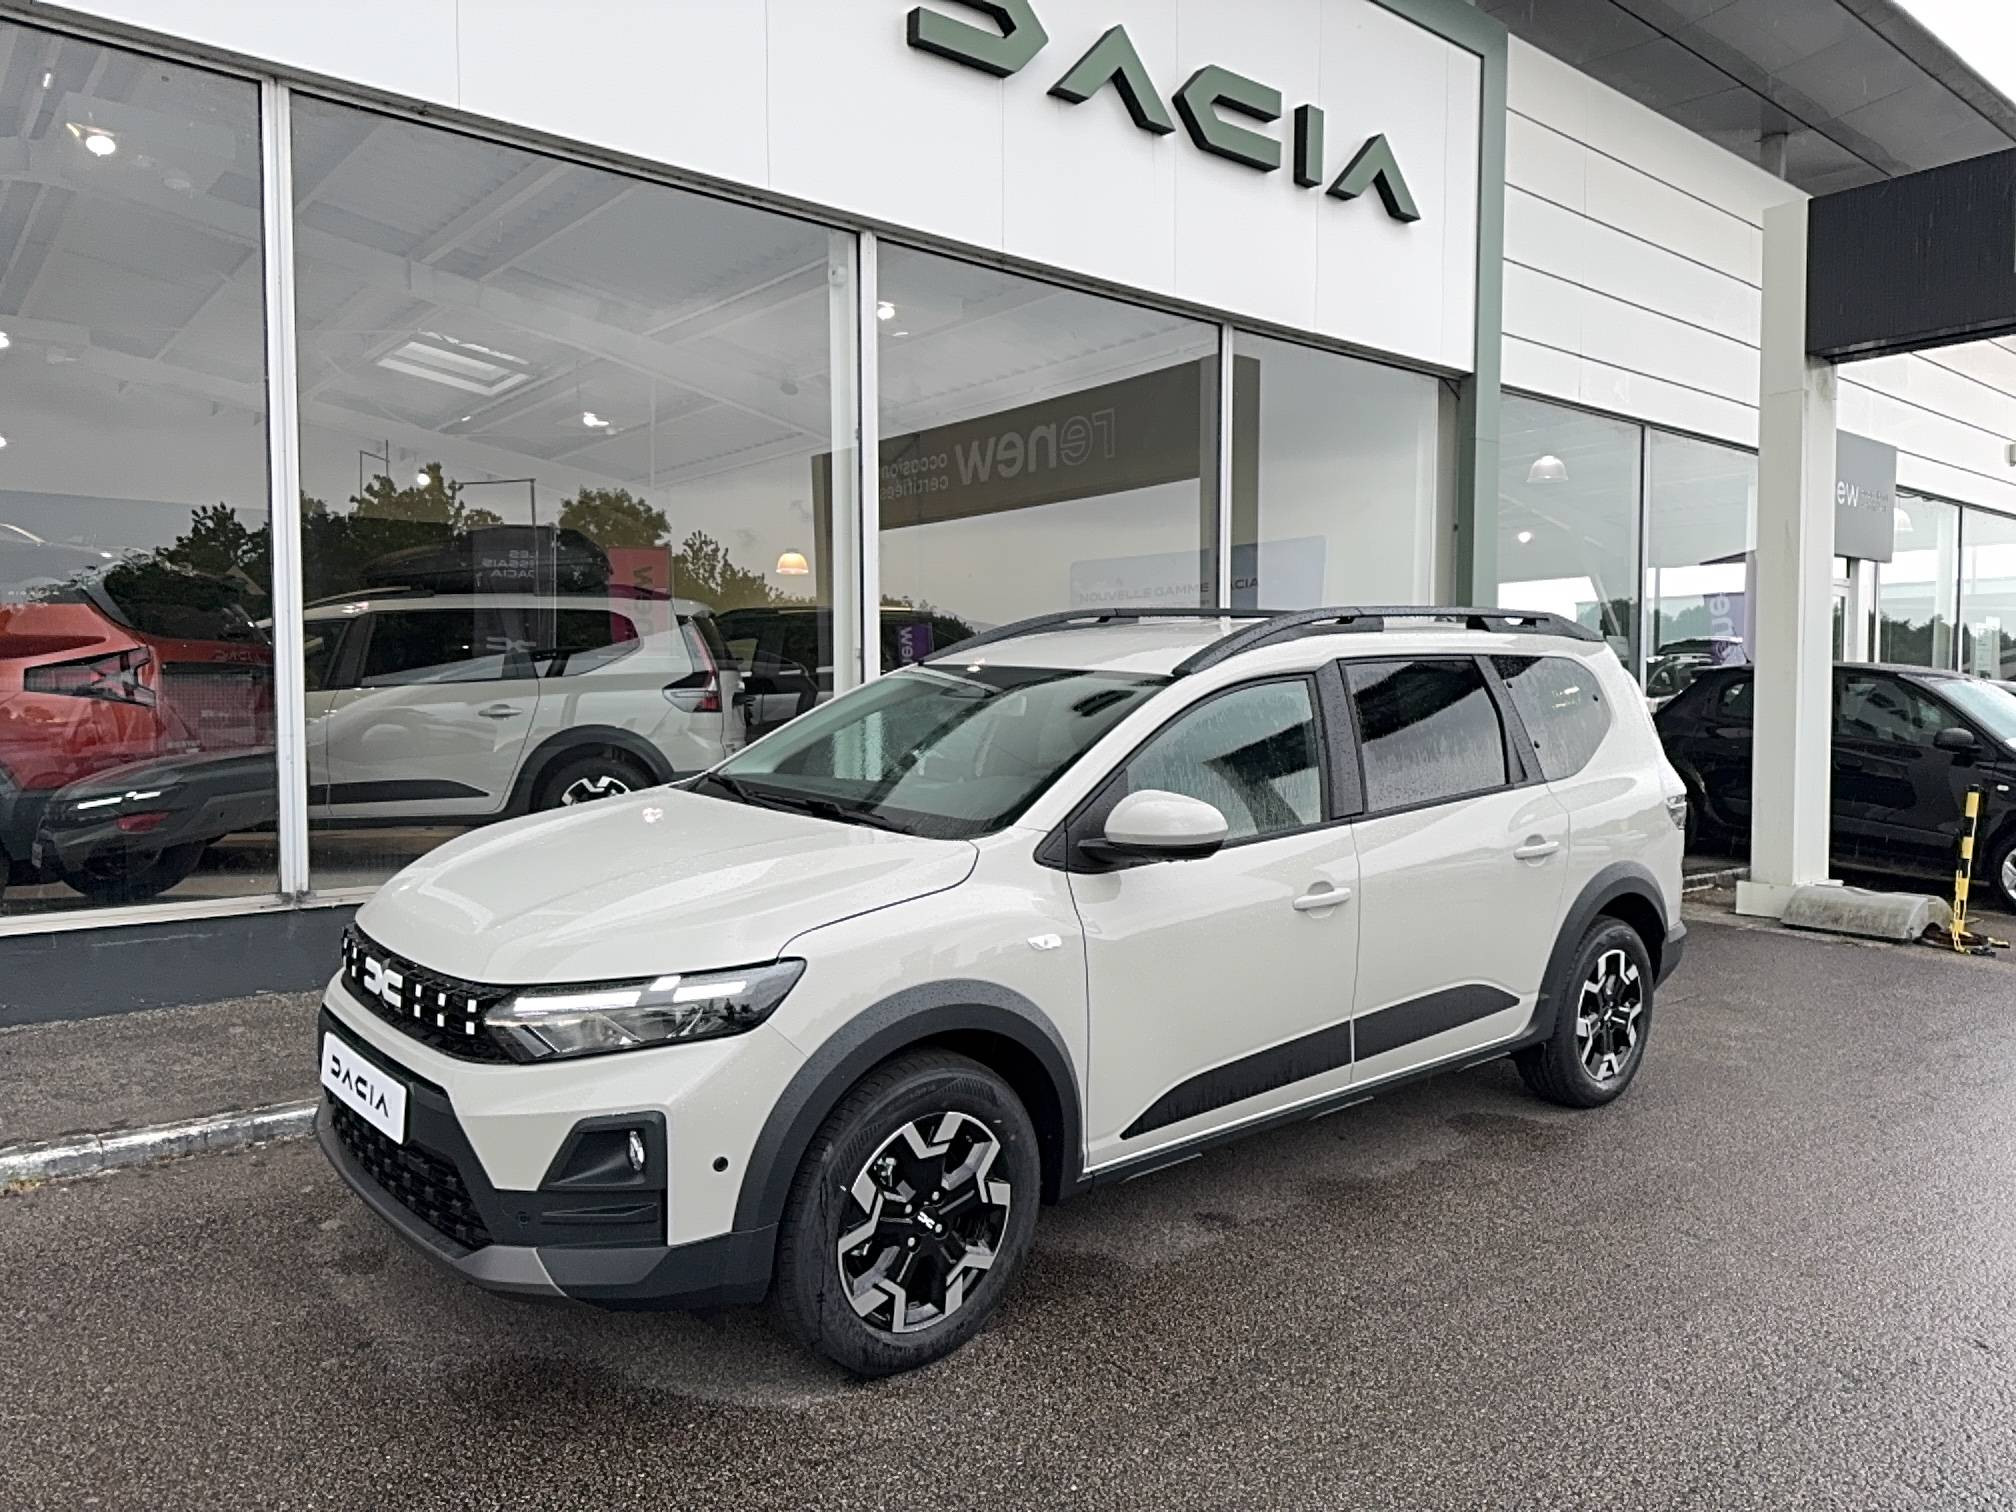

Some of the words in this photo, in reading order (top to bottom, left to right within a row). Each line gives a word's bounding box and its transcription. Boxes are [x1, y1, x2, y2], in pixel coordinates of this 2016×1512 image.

[907, 0, 1421, 223] DACIA
[1231, 576, 1258, 591] CIA
[330, 1053, 390, 1119] DACIA
